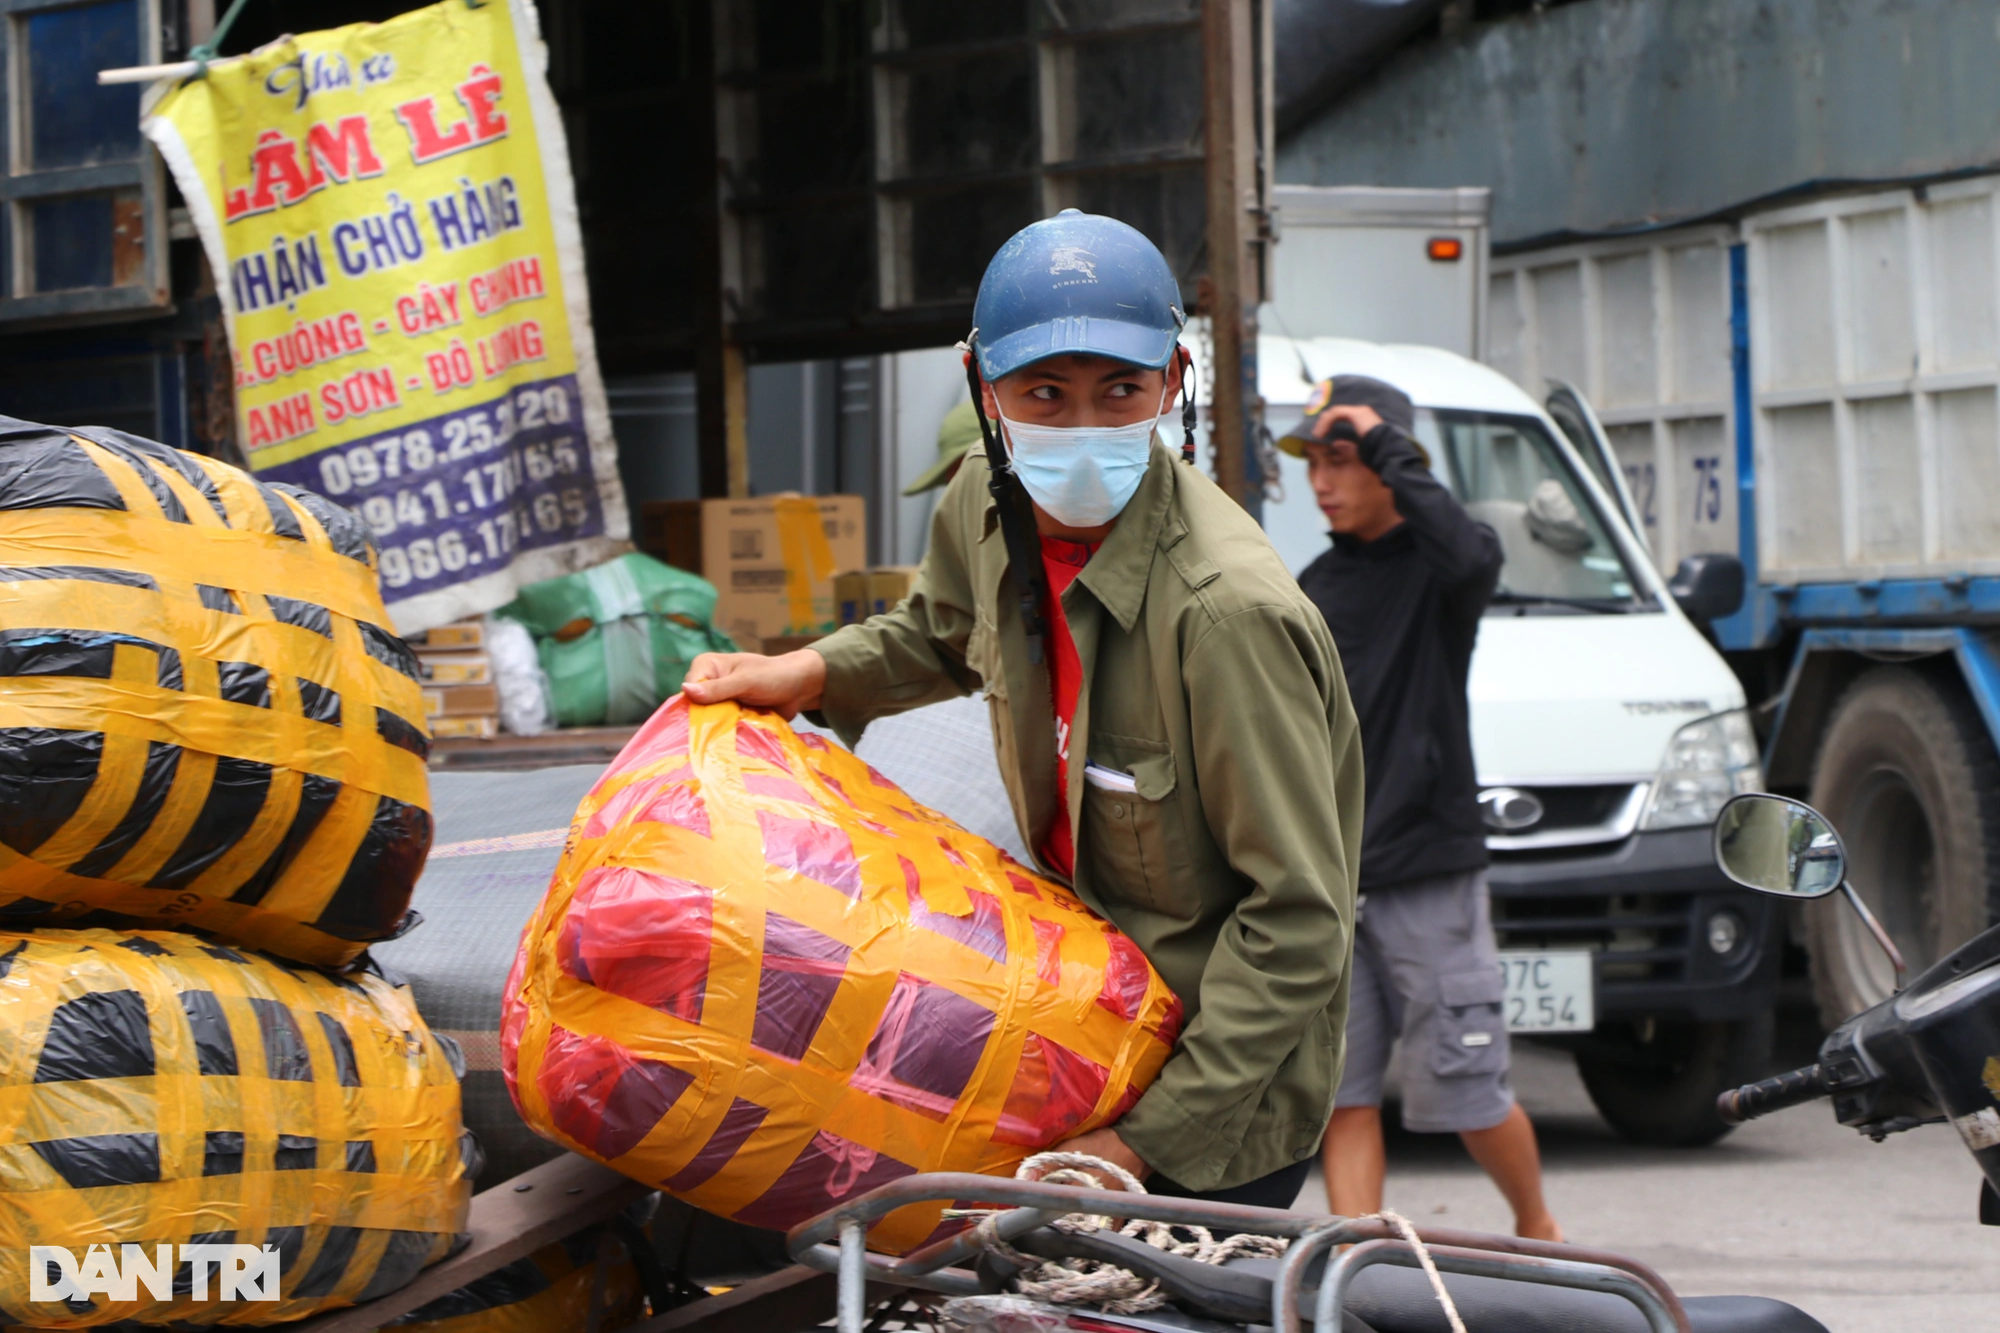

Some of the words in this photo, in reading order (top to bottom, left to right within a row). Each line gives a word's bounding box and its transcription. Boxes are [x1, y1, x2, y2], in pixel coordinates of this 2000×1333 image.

[395, 64, 509, 166] LÊ
[333, 192, 424, 277] CHỞ
[395, 281, 463, 337] CÂY
[247, 391, 317, 449] ANH
[320, 366, 400, 424] SƠN
[424, 339, 475, 395] ĐÔ
[1694, 457, 1721, 523] 75
